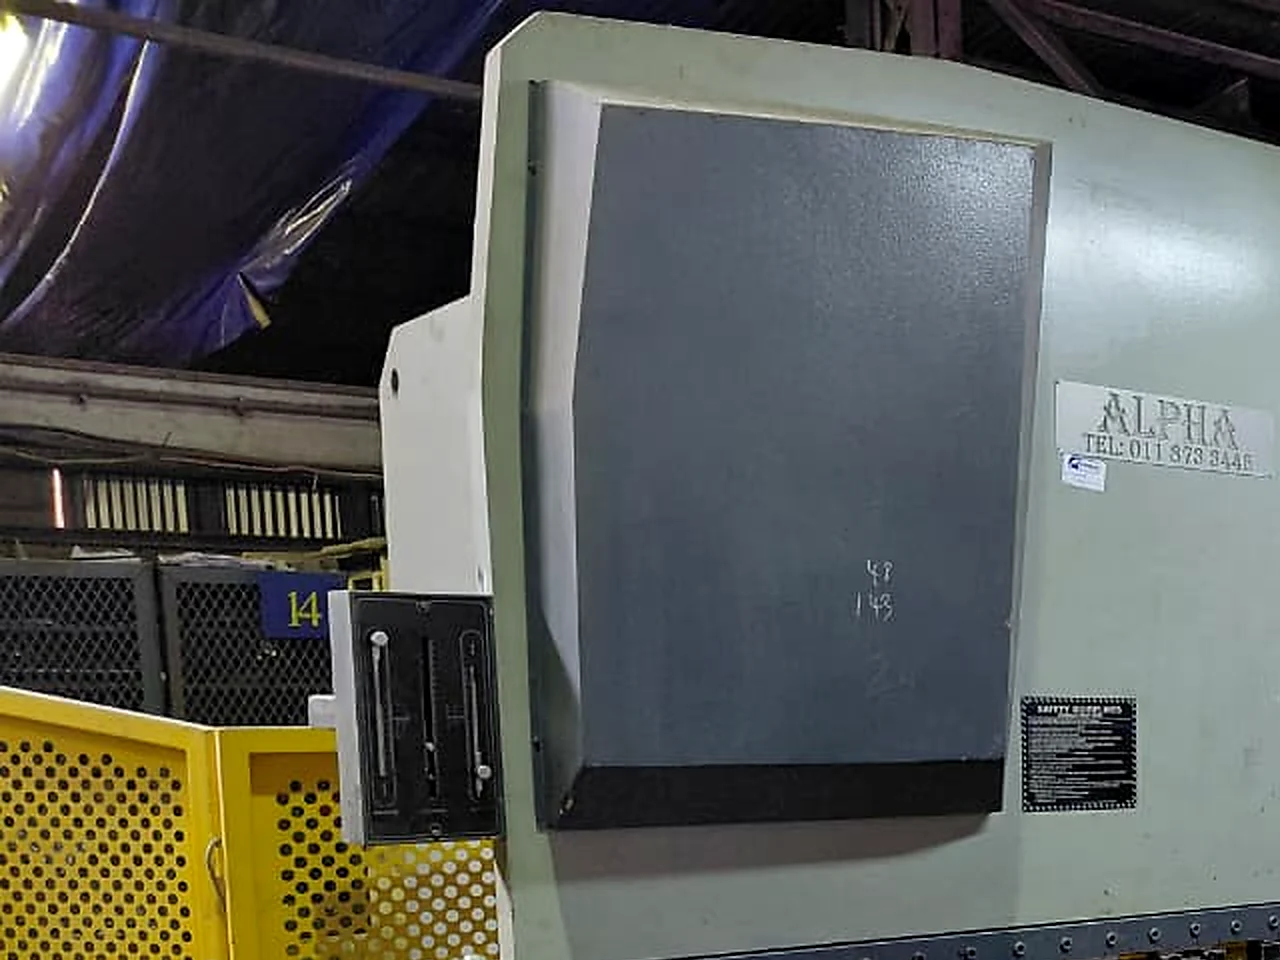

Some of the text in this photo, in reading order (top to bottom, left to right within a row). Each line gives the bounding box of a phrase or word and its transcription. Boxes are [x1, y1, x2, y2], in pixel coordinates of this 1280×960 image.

[1098, 391, 1241, 450] ALPHA
[1084, 432, 1124, 457] TEL:
[1129, 438, 1162, 463] 011
[287, 590, 322, 629] 14
